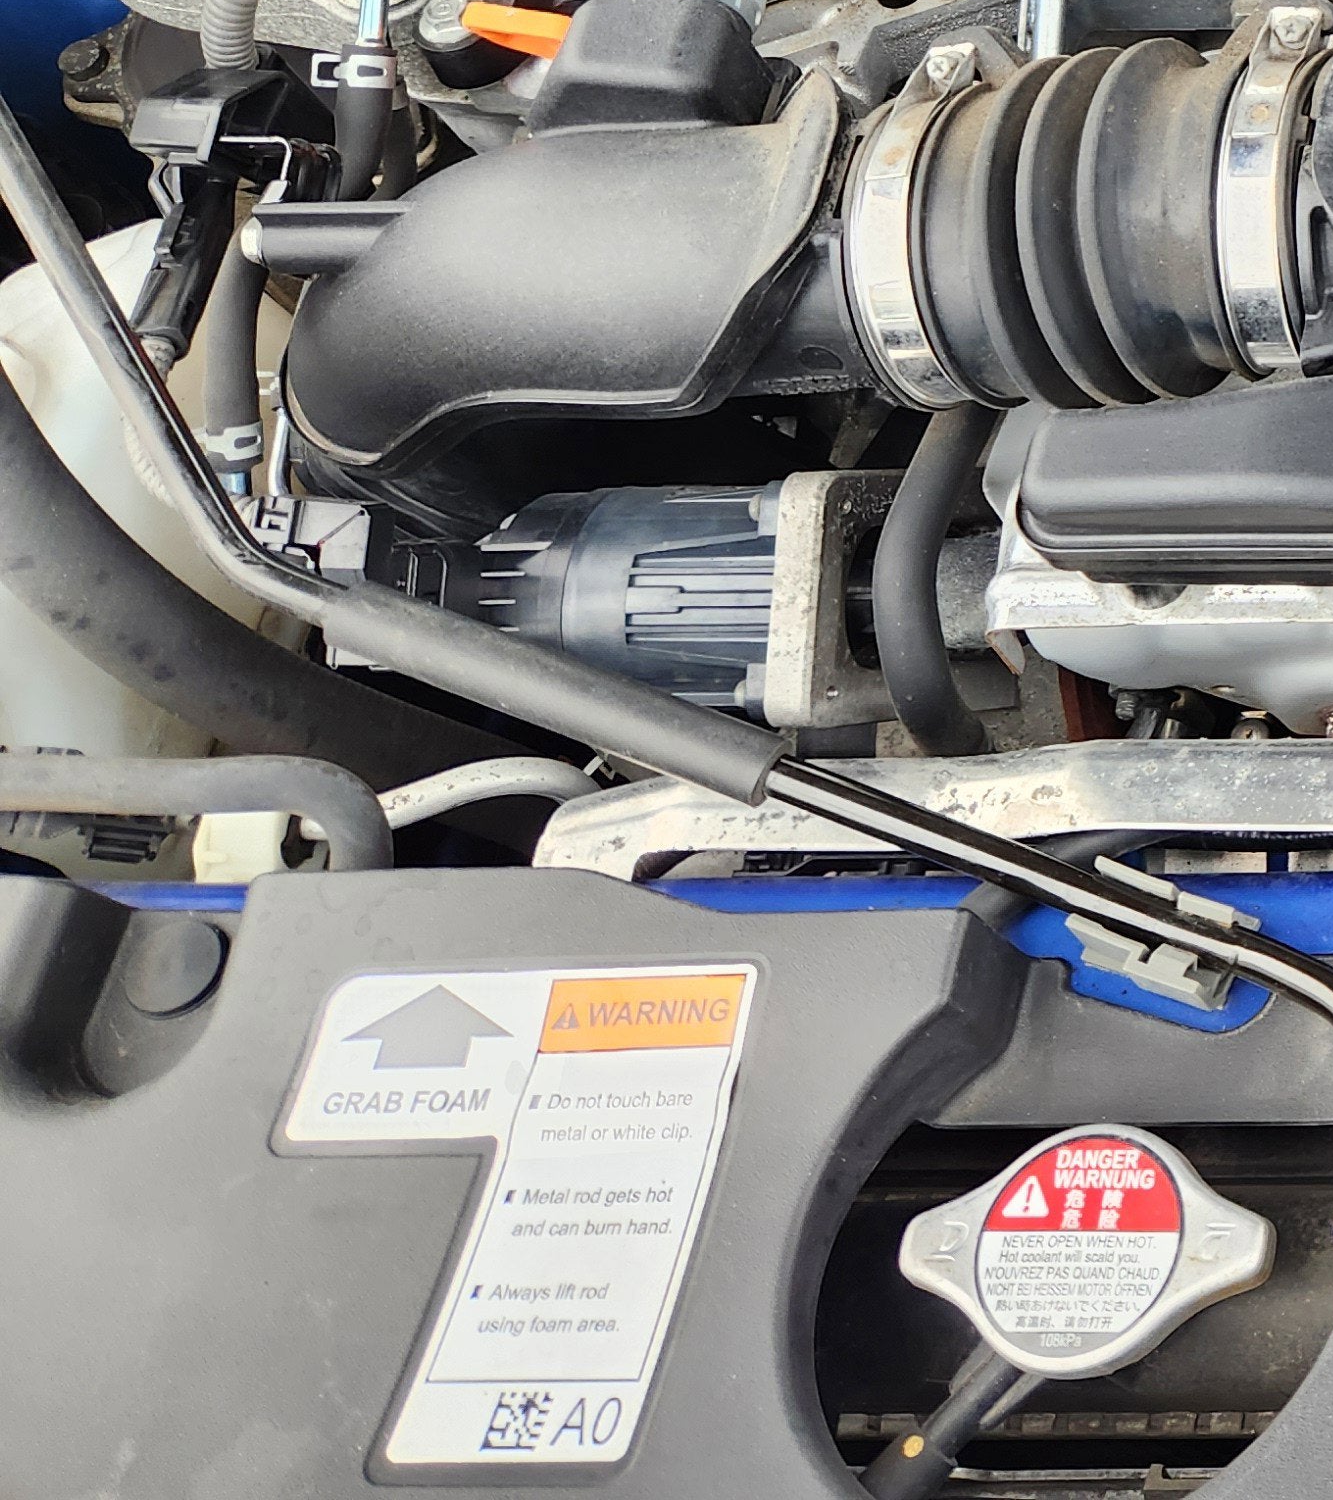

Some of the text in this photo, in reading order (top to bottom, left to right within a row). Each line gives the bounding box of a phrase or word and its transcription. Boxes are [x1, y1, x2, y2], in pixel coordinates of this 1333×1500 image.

[589, 998, 730, 1027] WARNING
[323, 1088, 491, 1114] GRAB FOAM
[547, 1090, 693, 1109] Do not touch bare
[541, 1123, 693, 1143] metal or white clip.
[1055, 1149, 1140, 1169] DANGER
[1054, 1169, 1156, 1190] WARNUNG
[523, 1187, 674, 1207] Metal rod gets hot
[512, 1219, 673, 1236] and can burn hand.
[1001, 1235, 1157, 1249] NEVER OPEN WHEN HOT.
[999, 1250, 1140, 1266] Hot coolant will scald you.
[984, 1266, 1044, 1280] N'OUVREZ
[1046, 1266, 1070, 1280] PAS
[1072, 1266, 1115, 1280] QUAND
[489, 1283, 610, 1302] Always lift rod
[986, 1282, 1015, 1297] NICHT
[1017, 1283, 1032, 1297] BEI
[1034, 1283, 1076, 1297] HEISSEM
[1077, 1283, 1112, 1297] MOTOR
[478, 1317, 620, 1336] using foam area.
[1040, 1333, 1083, 1348] 108kPa
[551, 1397, 623, 1446] A0
